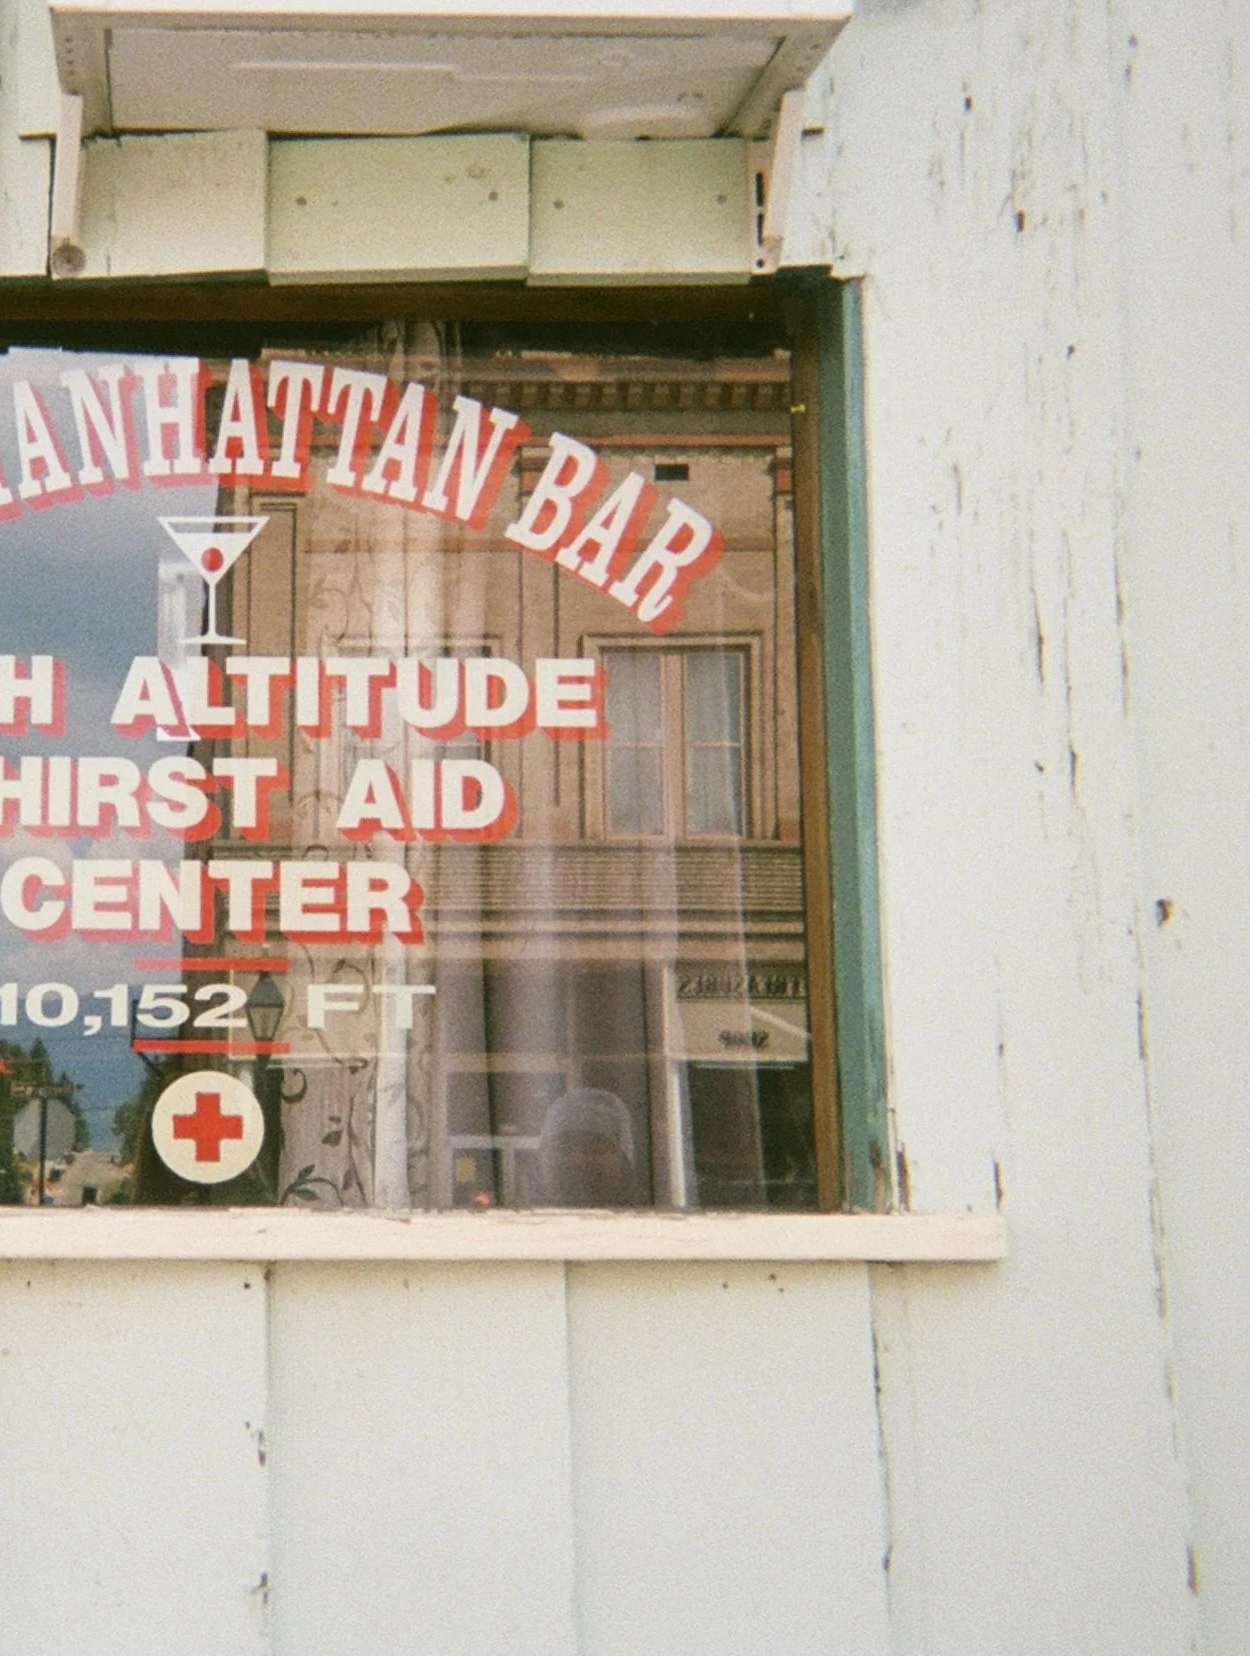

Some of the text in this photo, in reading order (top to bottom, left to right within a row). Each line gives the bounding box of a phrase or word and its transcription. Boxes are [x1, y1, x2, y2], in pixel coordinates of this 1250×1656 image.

[505, 430, 726, 635] BAR
[109, 655, 609, 740] ALTITUDE
[335, 757, 519, 842] AID
[0, 856, 425, 945] CENTER
[307, 983, 437, 1030] FT
